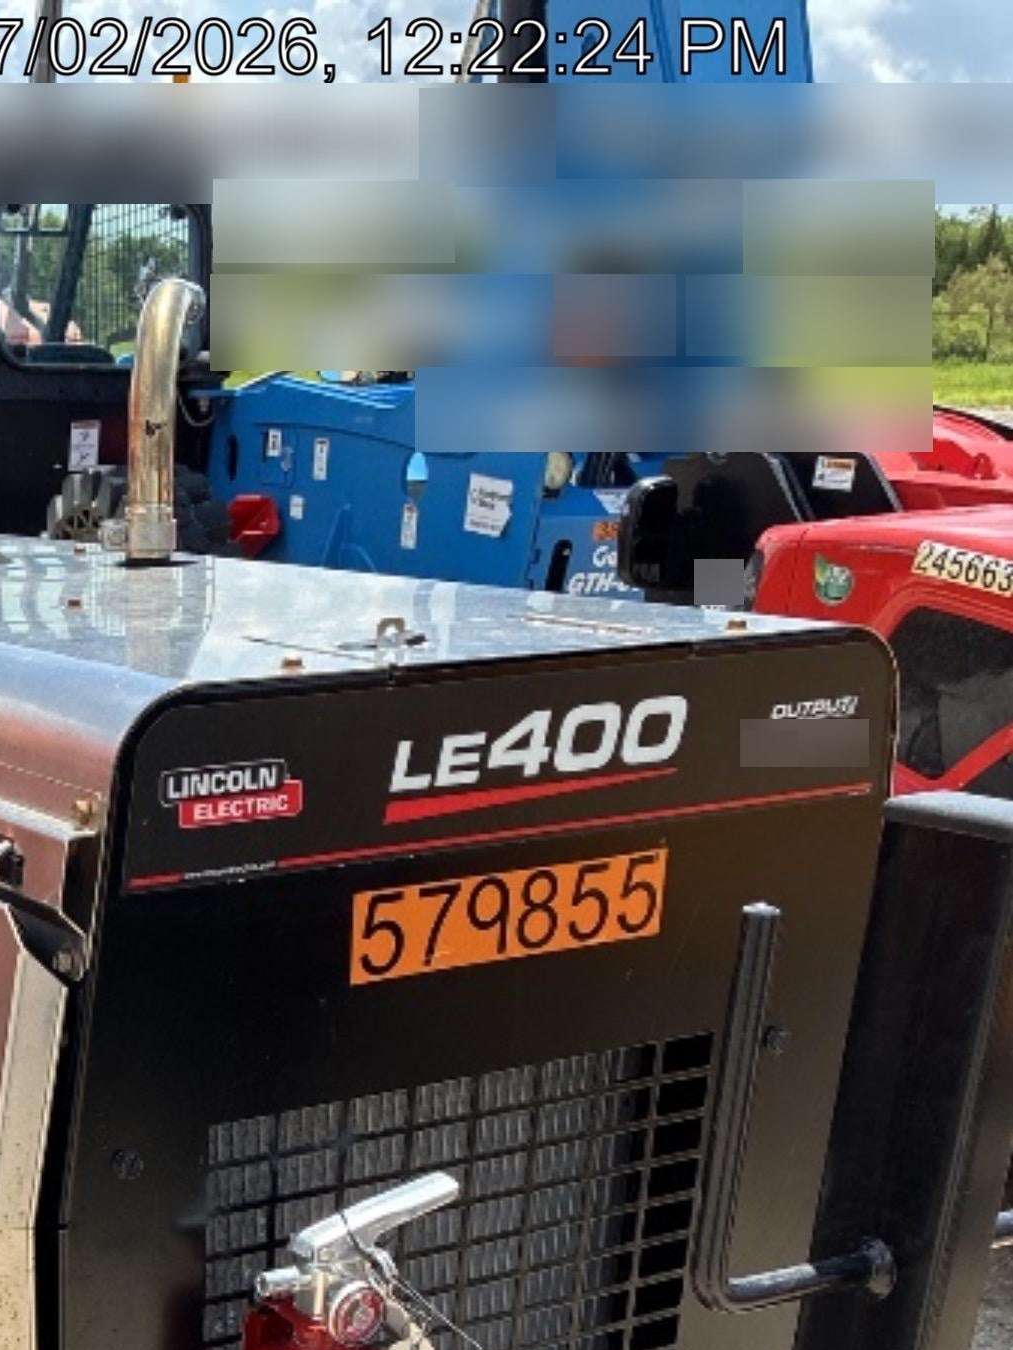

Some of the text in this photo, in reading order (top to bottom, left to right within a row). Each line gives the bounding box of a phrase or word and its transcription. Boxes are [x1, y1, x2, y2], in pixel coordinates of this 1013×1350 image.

[389, 695, 688, 793] LE400
[167, 766, 277, 799] LINCOLN
[193, 794, 289, 821] ELECTRIC
[358, 852, 660, 975] 579855
